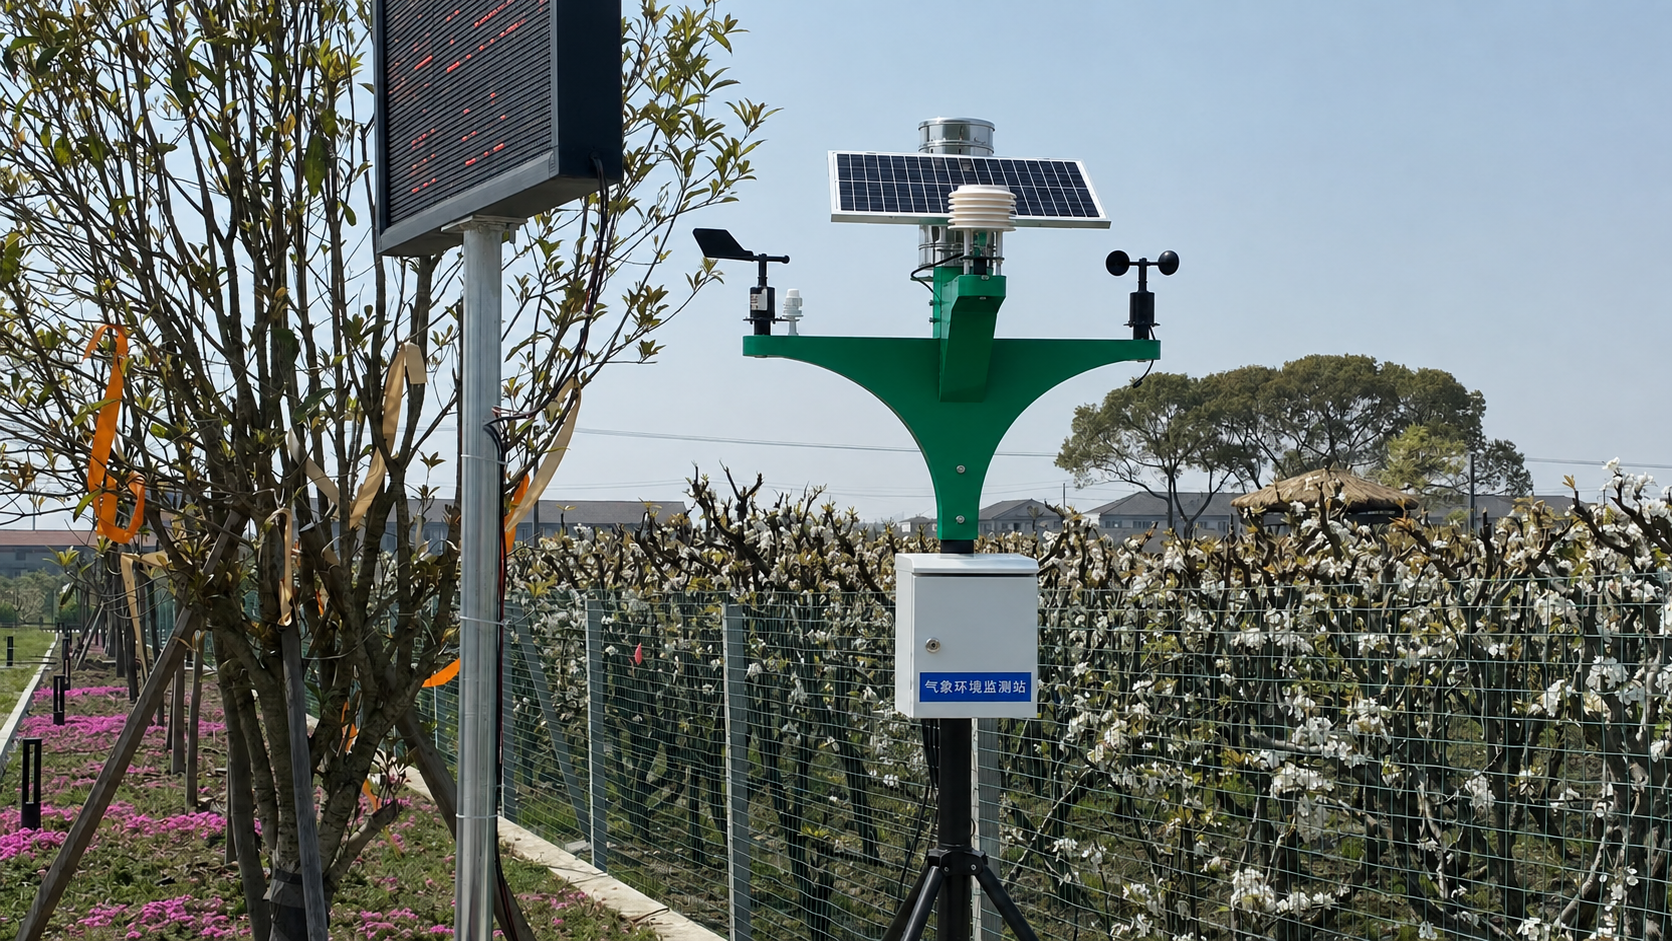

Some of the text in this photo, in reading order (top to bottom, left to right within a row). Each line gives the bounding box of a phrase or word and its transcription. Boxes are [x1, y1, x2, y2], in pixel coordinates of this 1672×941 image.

[924, 679, 1026, 694] 气象环境监测站
